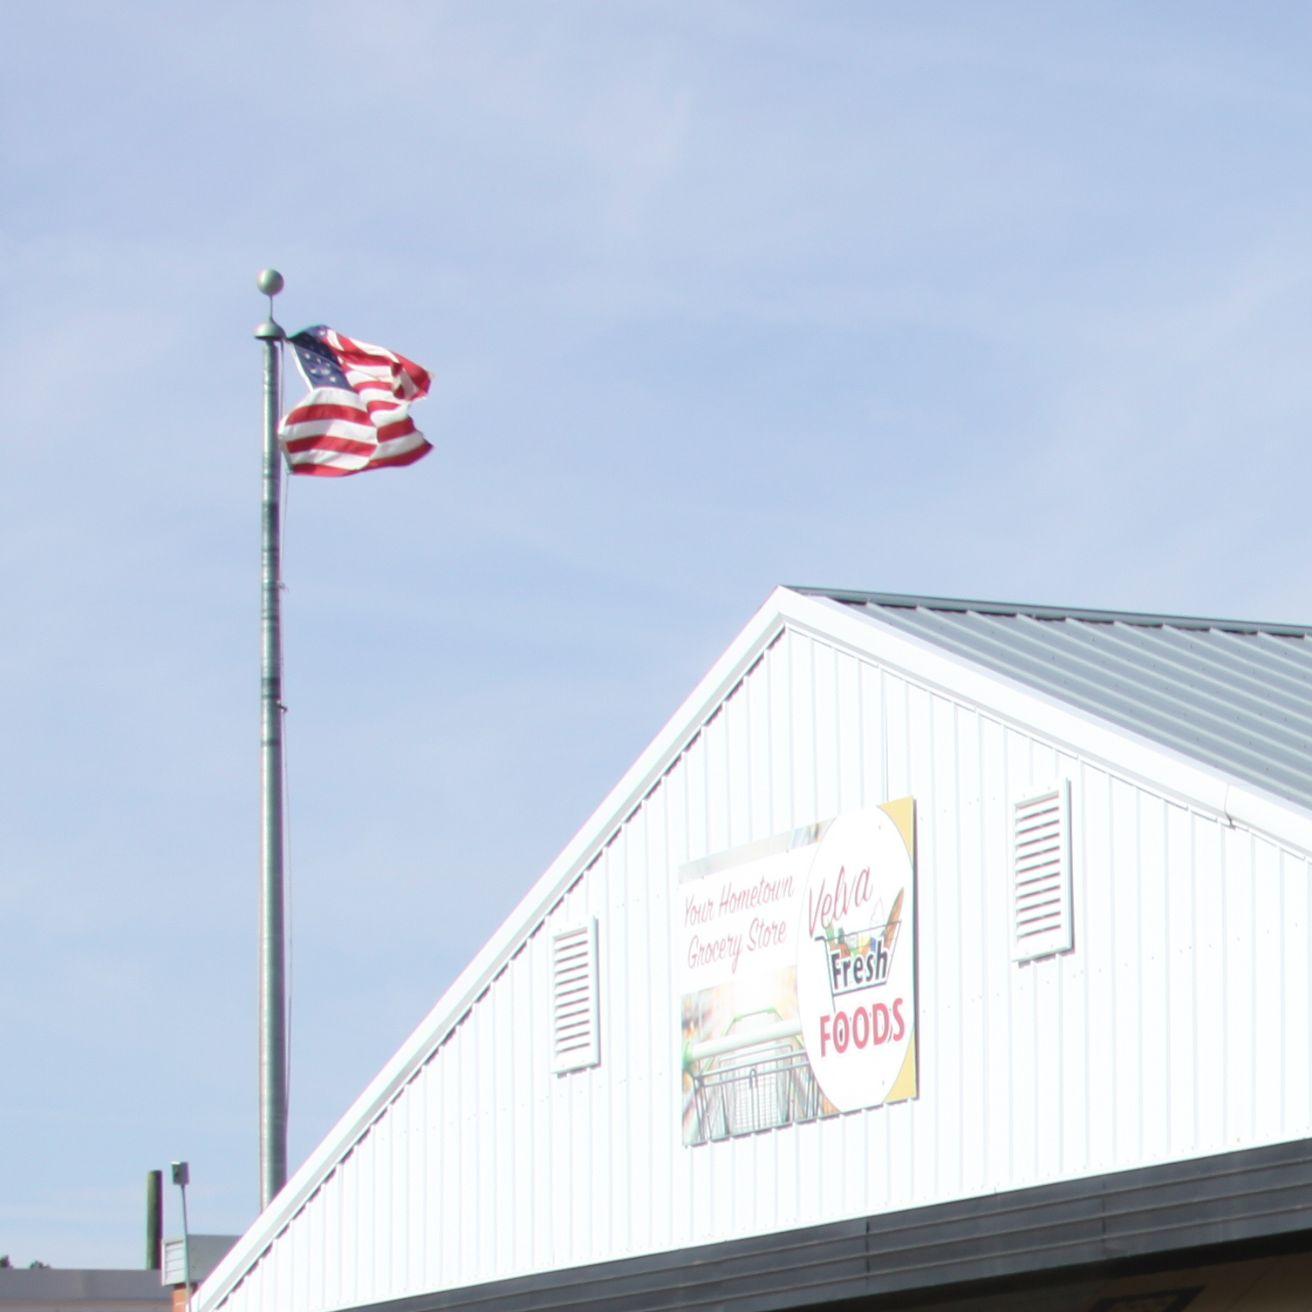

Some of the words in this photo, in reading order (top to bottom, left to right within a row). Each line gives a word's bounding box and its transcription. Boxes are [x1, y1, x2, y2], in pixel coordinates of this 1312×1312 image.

[684, 894, 715, 929] Your
[717, 873, 796, 917] Hometown
[807, 865, 874, 938] Velva
[687, 935, 743, 975] Grocery
[746, 918, 788, 953] Store
[830, 937, 889, 991] Fresh
[819, 998, 906, 1058] FOODS
